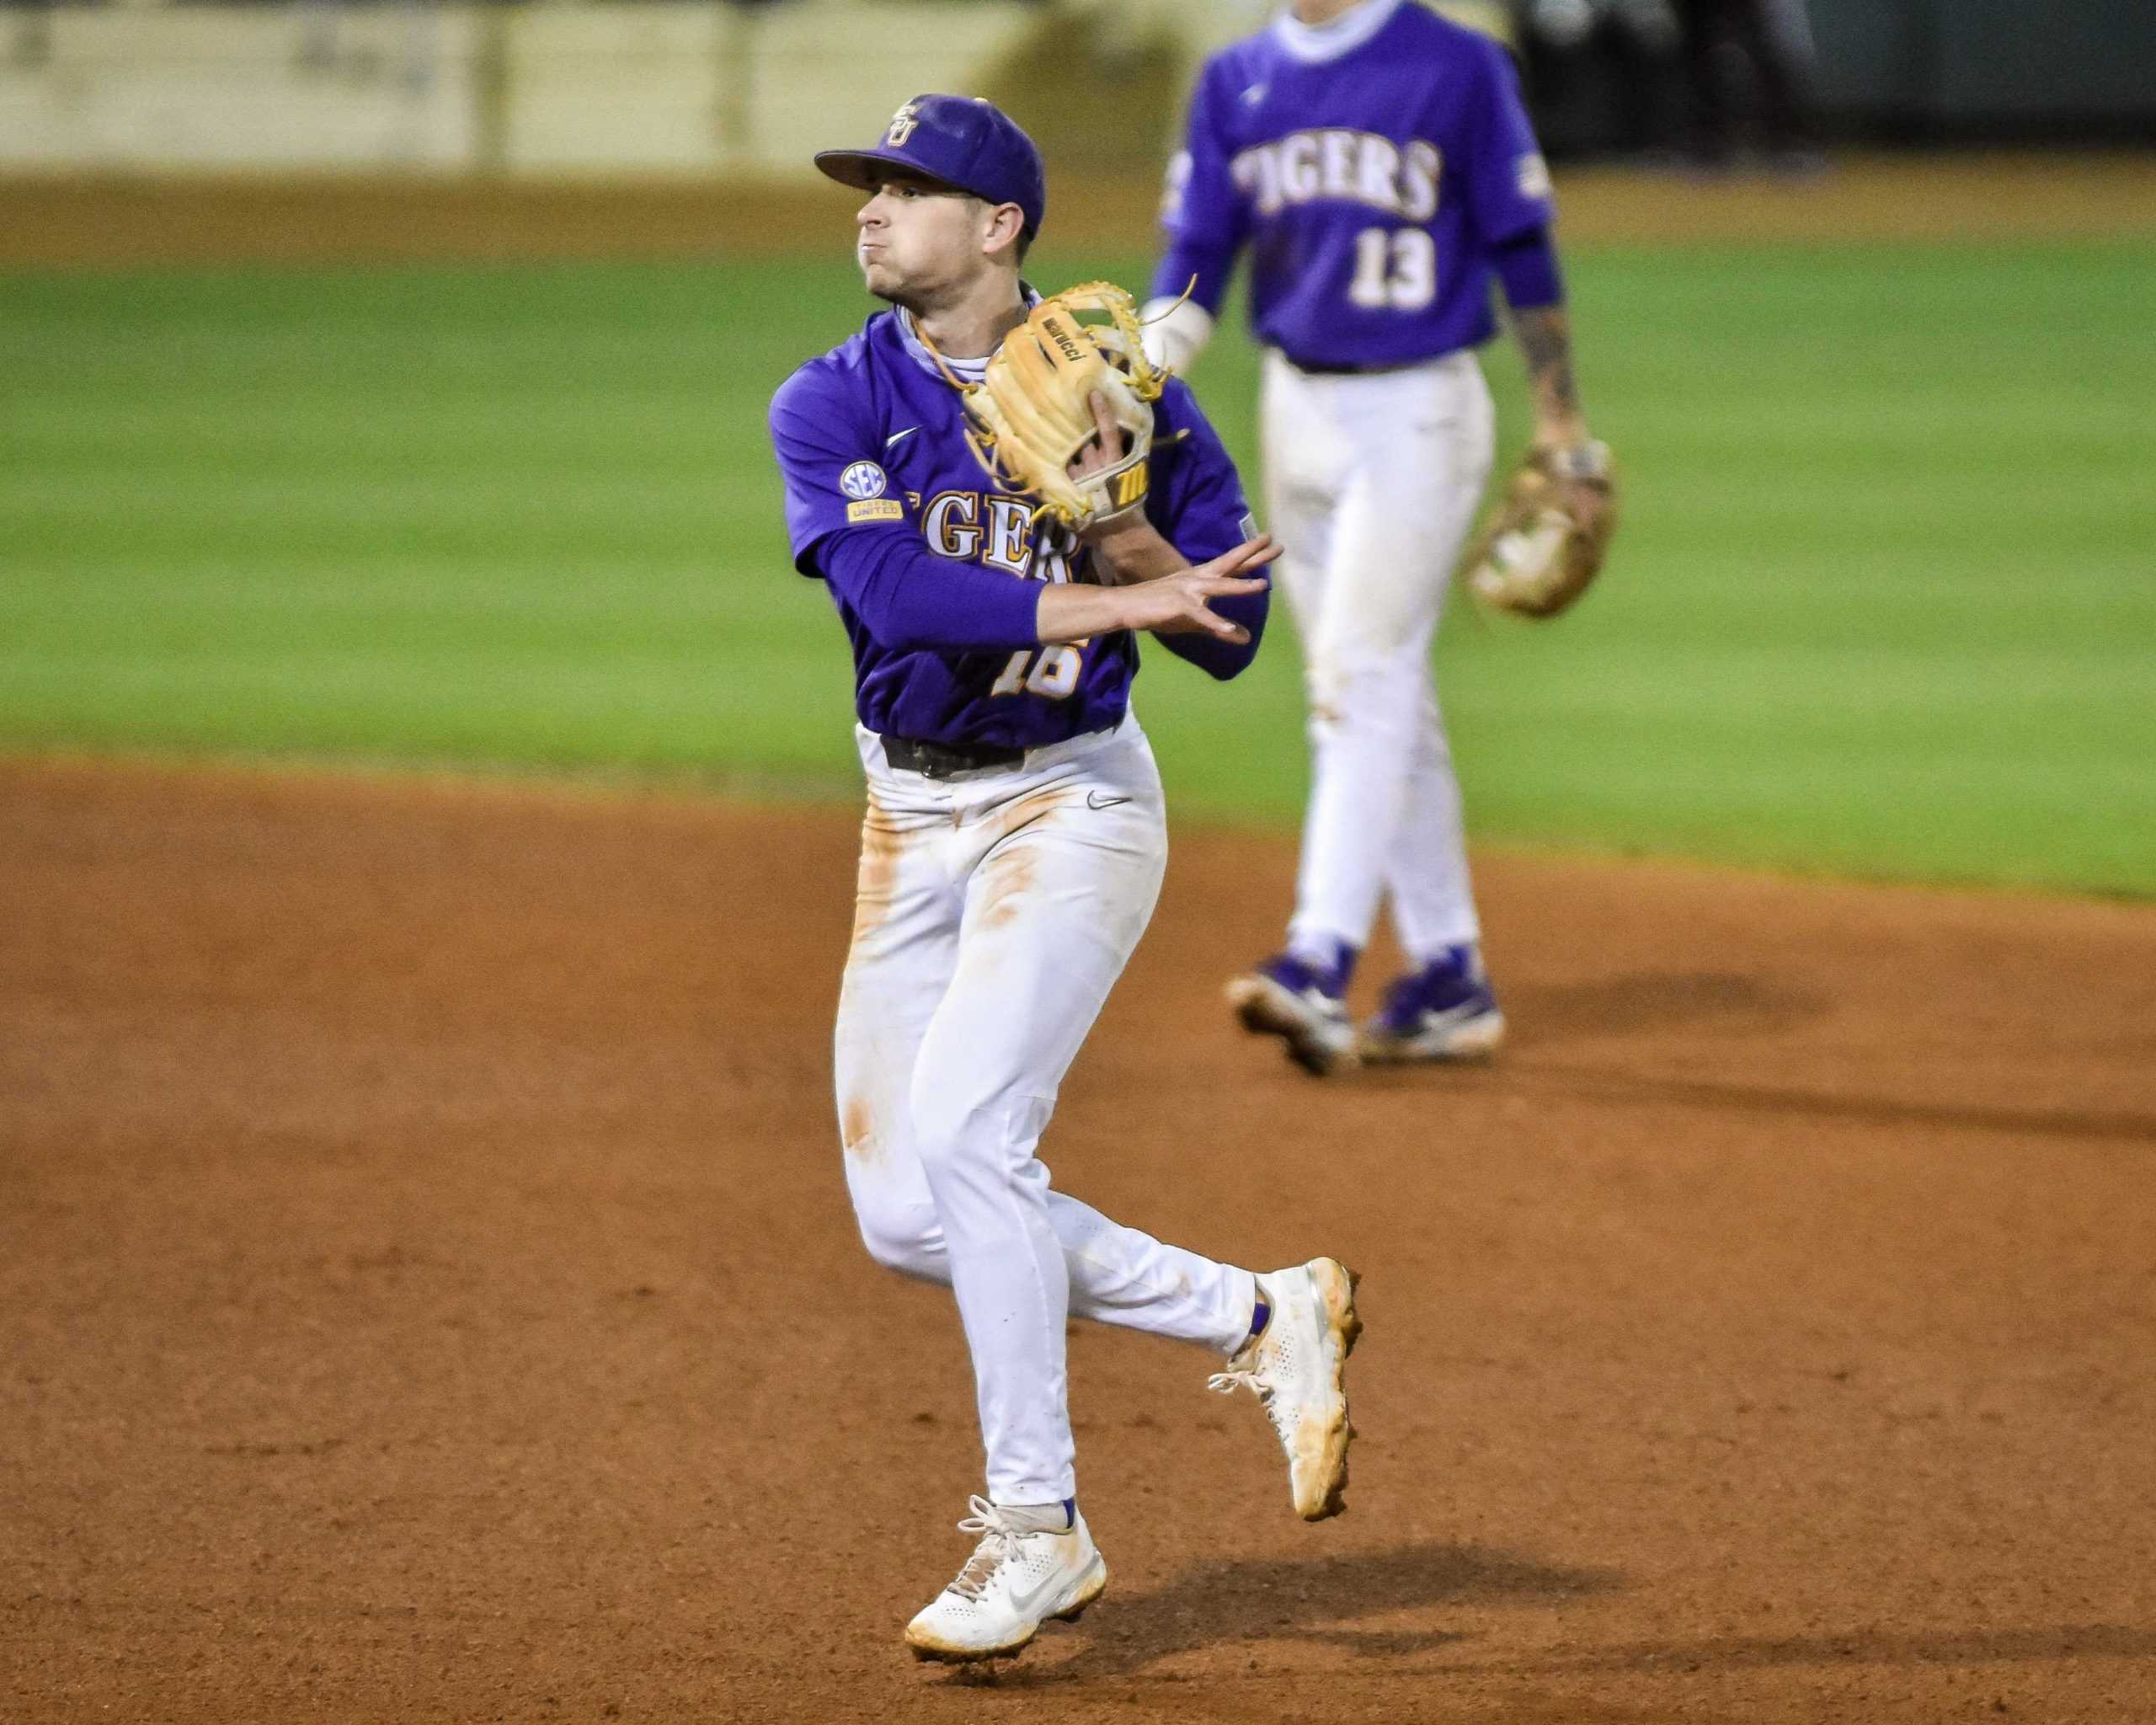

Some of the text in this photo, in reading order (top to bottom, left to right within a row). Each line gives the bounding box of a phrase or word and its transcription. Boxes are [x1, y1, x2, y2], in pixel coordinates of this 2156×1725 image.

[888, 105, 917, 148] SU
[1228, 126, 1444, 223] TIGERS
[1347, 226, 1437, 311] 13
[843, 463, 883, 498] SEC
[853, 506, 898, 517] UNITED
[905, 490, 1083, 584] GER
